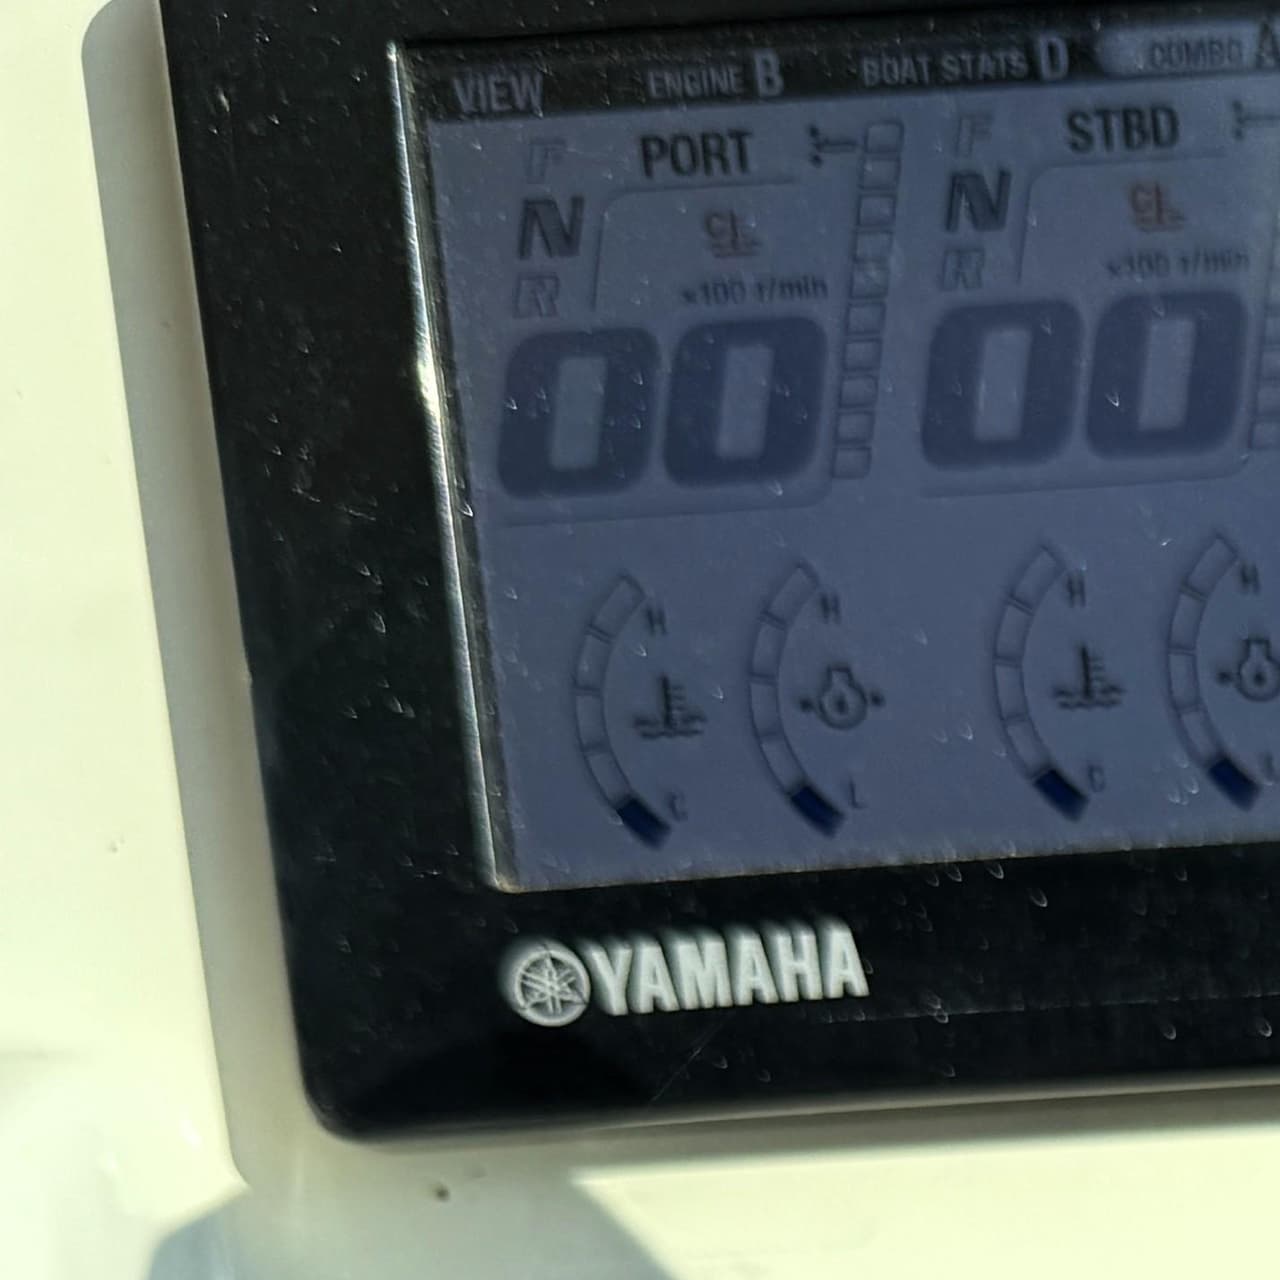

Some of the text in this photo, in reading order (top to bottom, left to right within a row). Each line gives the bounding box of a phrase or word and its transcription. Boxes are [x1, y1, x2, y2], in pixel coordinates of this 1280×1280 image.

[648, 50, 783, 98] ENGINE B
[863, 37, 1069, 86] BOAT STATS D
[1151, 37, 1242, 70] COMBO
[453, 70, 543, 113] VIEW
[1066, 103, 1181, 152] STBD
[640, 129, 753, 179] PORT
[945, 170, 1012, 233] N
[518, 195, 584, 259] N
[587, 919, 870, 1016] YAMAHA
